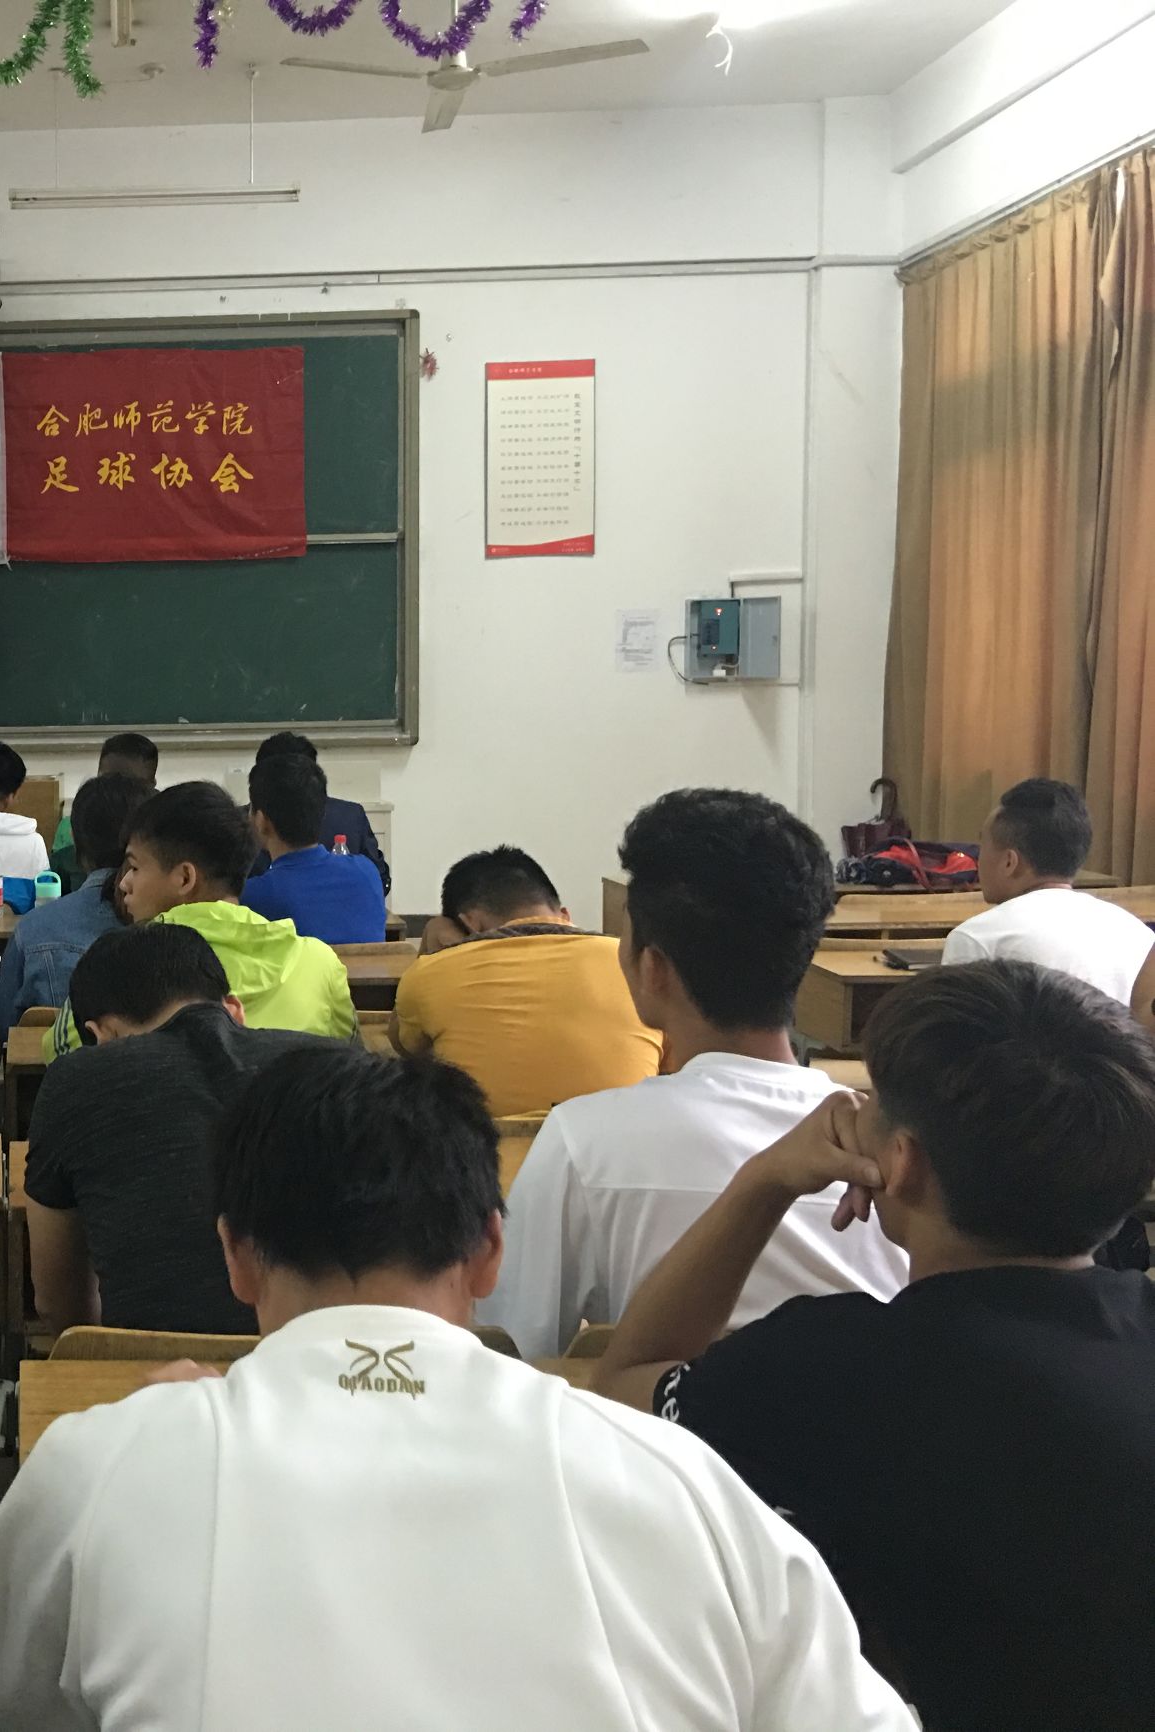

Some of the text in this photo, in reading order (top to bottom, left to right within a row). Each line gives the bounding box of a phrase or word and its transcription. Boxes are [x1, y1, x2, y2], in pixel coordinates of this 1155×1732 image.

[36, 400, 254, 437] 合肥师范学院
[40, 452, 255, 494] 足球协会
[338, 1374, 425, 1395] QIAODAN
